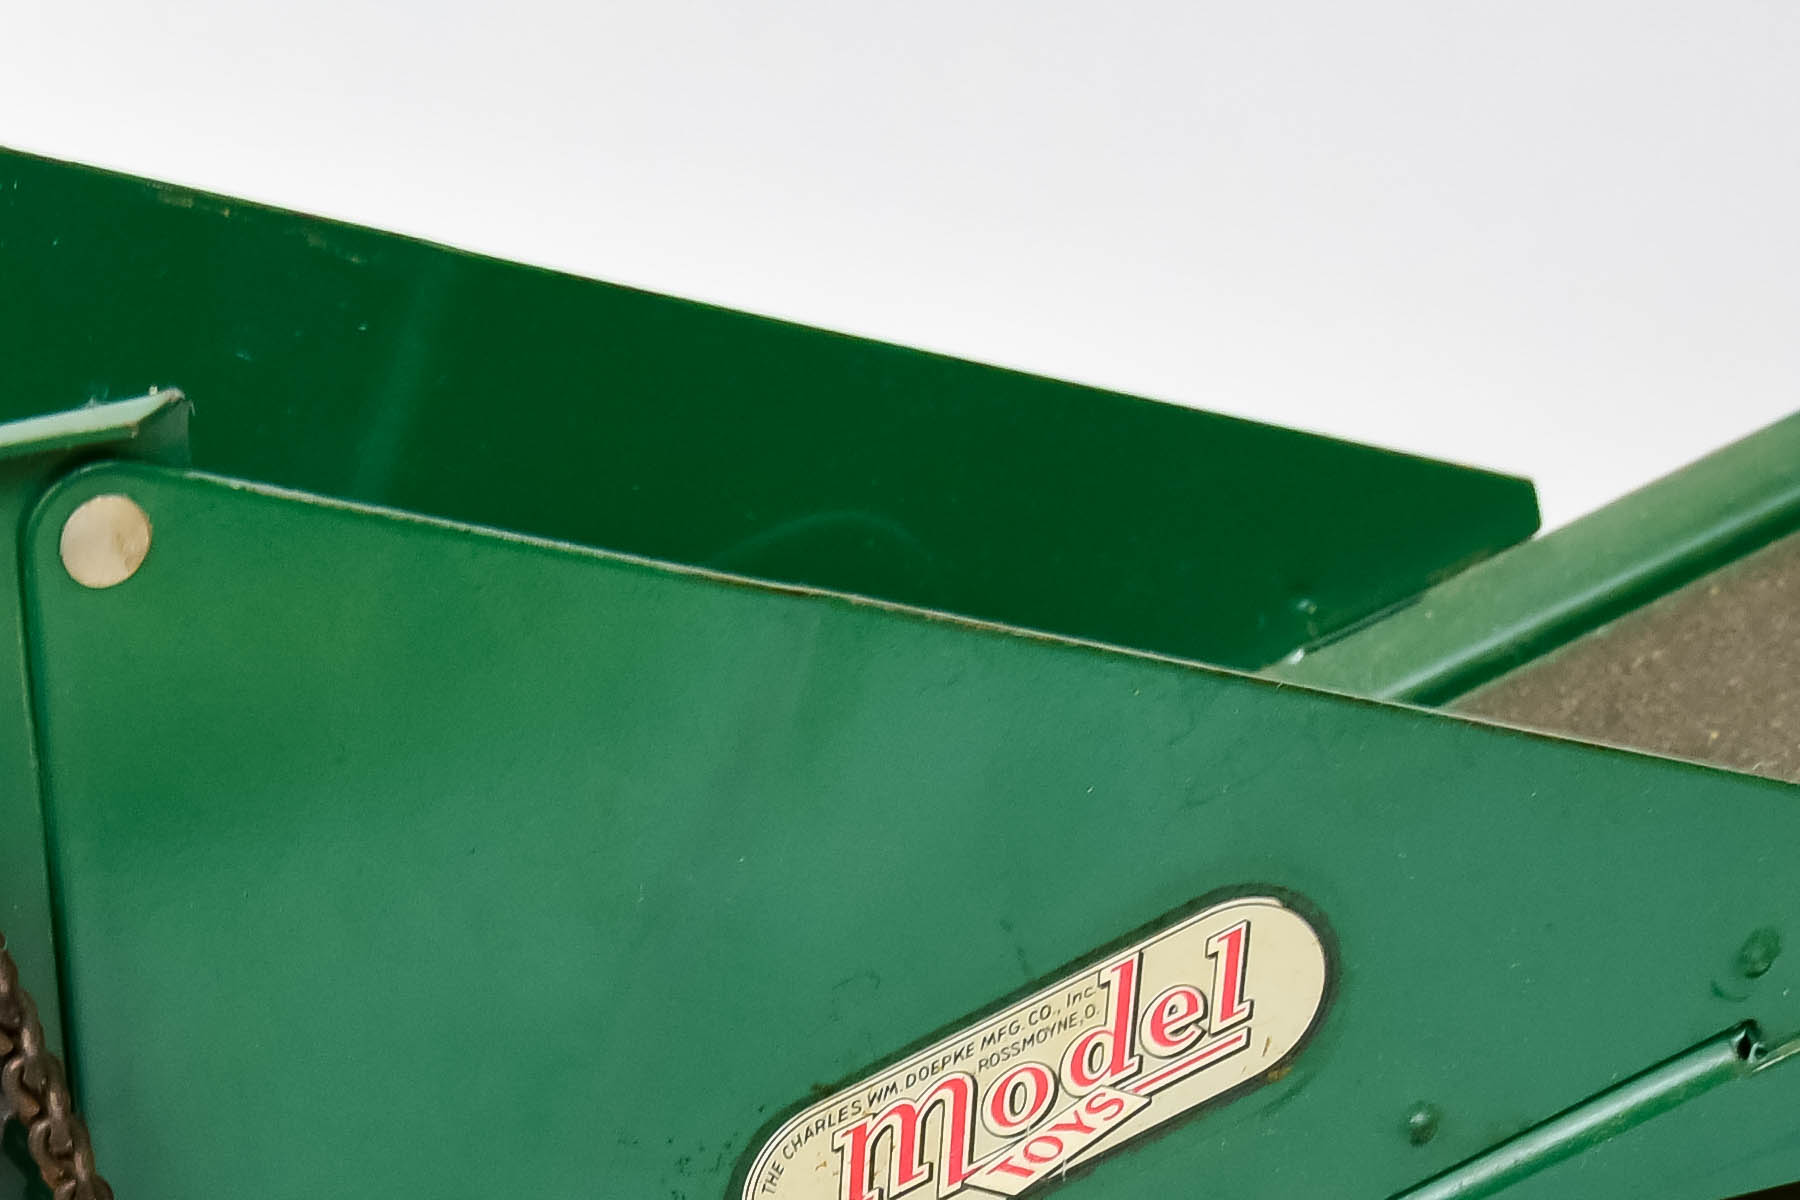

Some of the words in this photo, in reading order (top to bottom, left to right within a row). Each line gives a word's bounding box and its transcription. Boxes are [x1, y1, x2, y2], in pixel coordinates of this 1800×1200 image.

[761, 1160, 785, 1194] THE
[782, 1100, 862, 1160] CHARLES
[905, 1042, 975, 1089] DOEPKE
[980, 1018, 1025, 1051] MFG.
[988, 1091, 1124, 1178] TOYS
